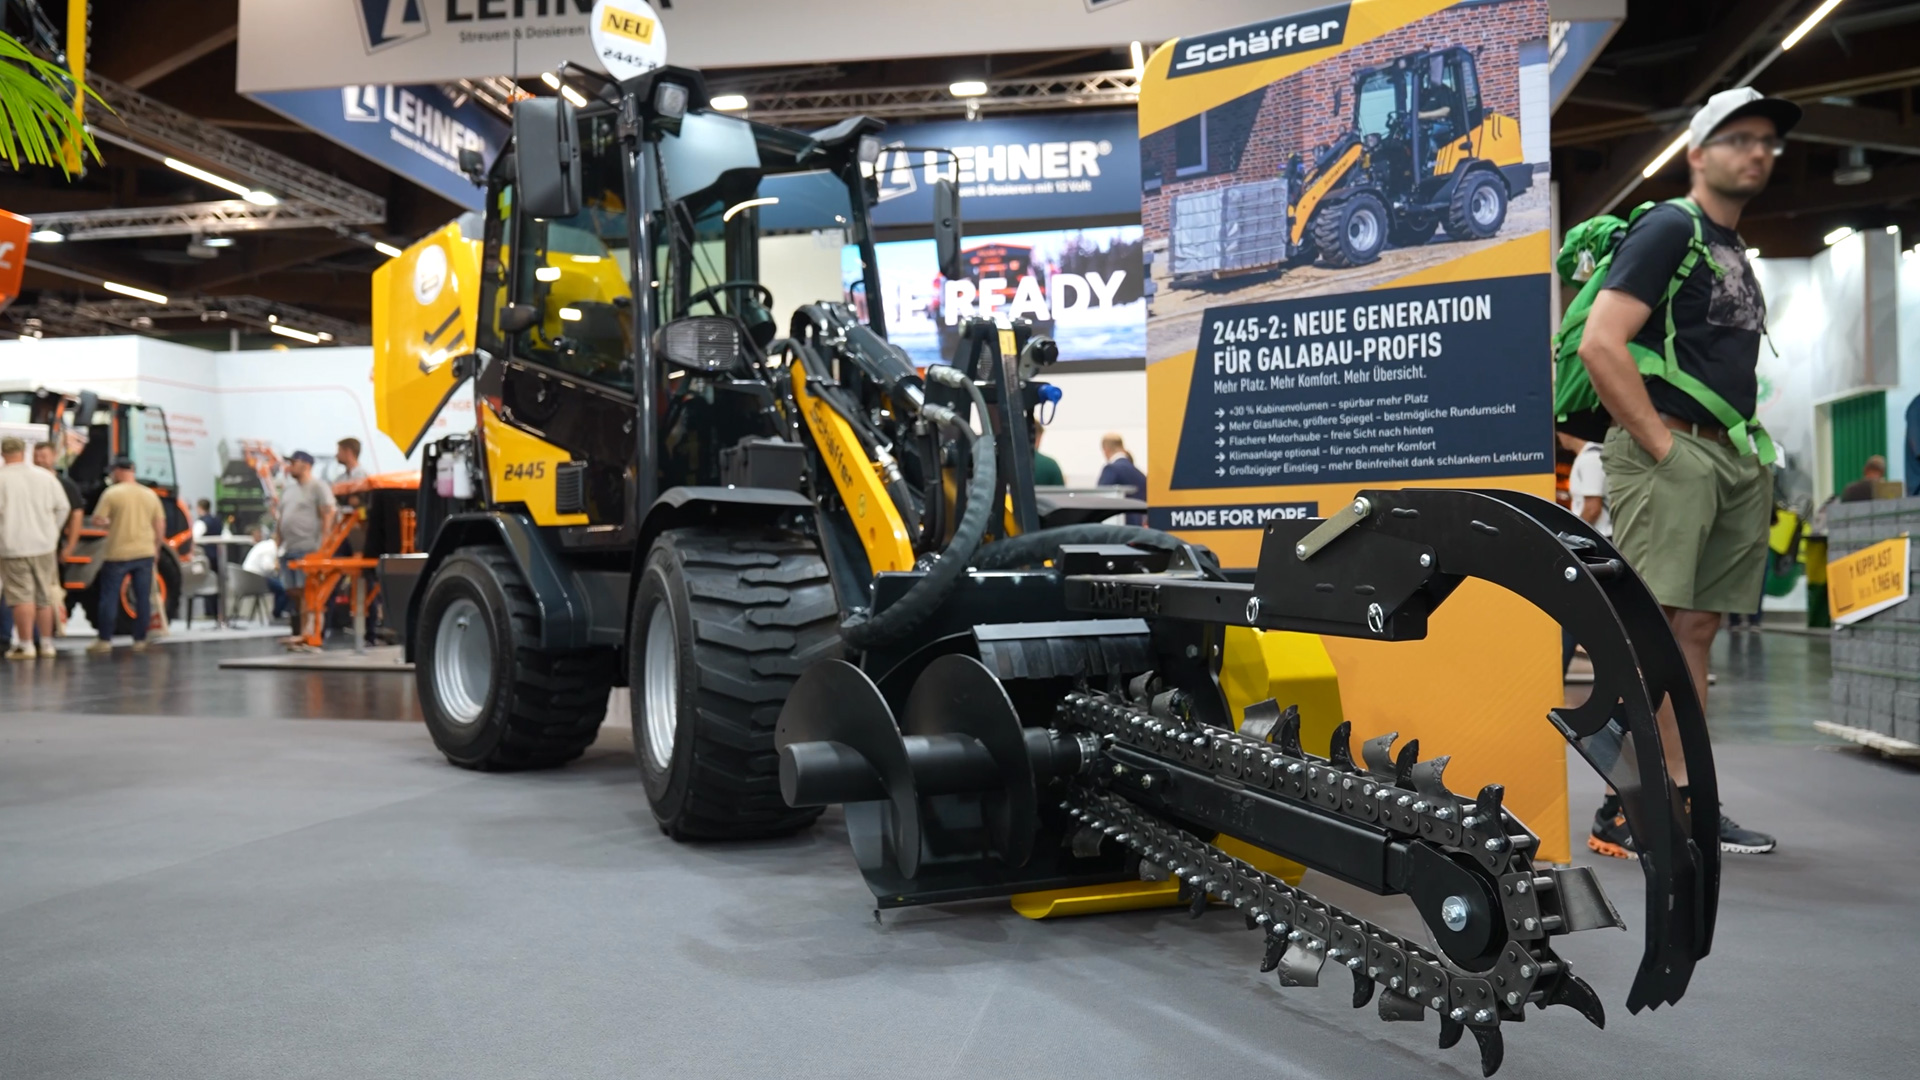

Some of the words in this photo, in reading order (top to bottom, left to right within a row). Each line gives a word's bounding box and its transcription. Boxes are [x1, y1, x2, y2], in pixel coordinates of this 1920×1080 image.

[606, 13, 652, 39] NEU
[1176, 20, 1340, 70] Schäffer
[944, 270, 1127, 326] READY
[1213, 314, 1287, 345] 2445-2:
[1294, 308, 1347, 337] NEUE
[1353, 294, 1491, 331] GENERATION
[1214, 345, 1251, 375] FÜR
[1258, 332, 1442, 372] GALABAU-PROFIS
[1214, 380, 1238, 394] Mehr
[1241, 377, 1268, 393] Platz.
[1271, 375, 1295, 390] Mehr
[1298, 372, 1341, 387] Komfort.
[1344, 368, 1370, 384] Mehr
[1373, 364, 1427, 381] Übersicht.
[1229, 406, 1244, 416] +30
[1246, 405, 1254, 415] %
[1256, 402, 1329, 415] Kabinenvolumen
[1338, 398, 1375, 410] spürbar
[1377, 395, 1402, 406] mehr
[1404, 394, 1428, 404] Platz
[1229, 421, 1250, 431] Mehr
[1253, 418, 1301, 430] Glasfläche,
[1303, 416, 1338, 429] größere
[1339, 412, 1373, 426] Spiegel
[1384, 408, 1448, 422] bestmögliche
[1450, 404, 1516, 417] Rundumsicht
[1229, 436, 1266, 446] Flachere
[1268, 432, 1321, 444] Motorhaube
[1331, 429, 1351, 439] freie
[1353, 427, 1377, 438] Sicht
[1379, 427, 1401, 437] nach
[1403, 425, 1433, 436] hinten
[1229, 449, 1283, 461] Klimaanlage
[1284, 447, 1320, 459] optional
[1330, 445, 1344, 455] für
[1345, 444, 1367, 454] noch
[1370, 443, 1395, 453] mehr
[1397, 441, 1436, 452] Komfort
[1229, 465, 1282, 477] Großzügiger
[1283, 462, 1319, 474] Einstieg
[1328, 460, 1352, 471] mehr
[1355, 457, 1409, 470] Beinfreiheit
[1411, 456, 1435, 467] dank
[1437, 453, 1491, 466] schlankem
[1493, 451, 1544, 463] Lenkturm
[504, 461, 546, 481] 2445
[1171, 510, 1217, 526] MADE
[1219, 509, 1254, 525] FOR
